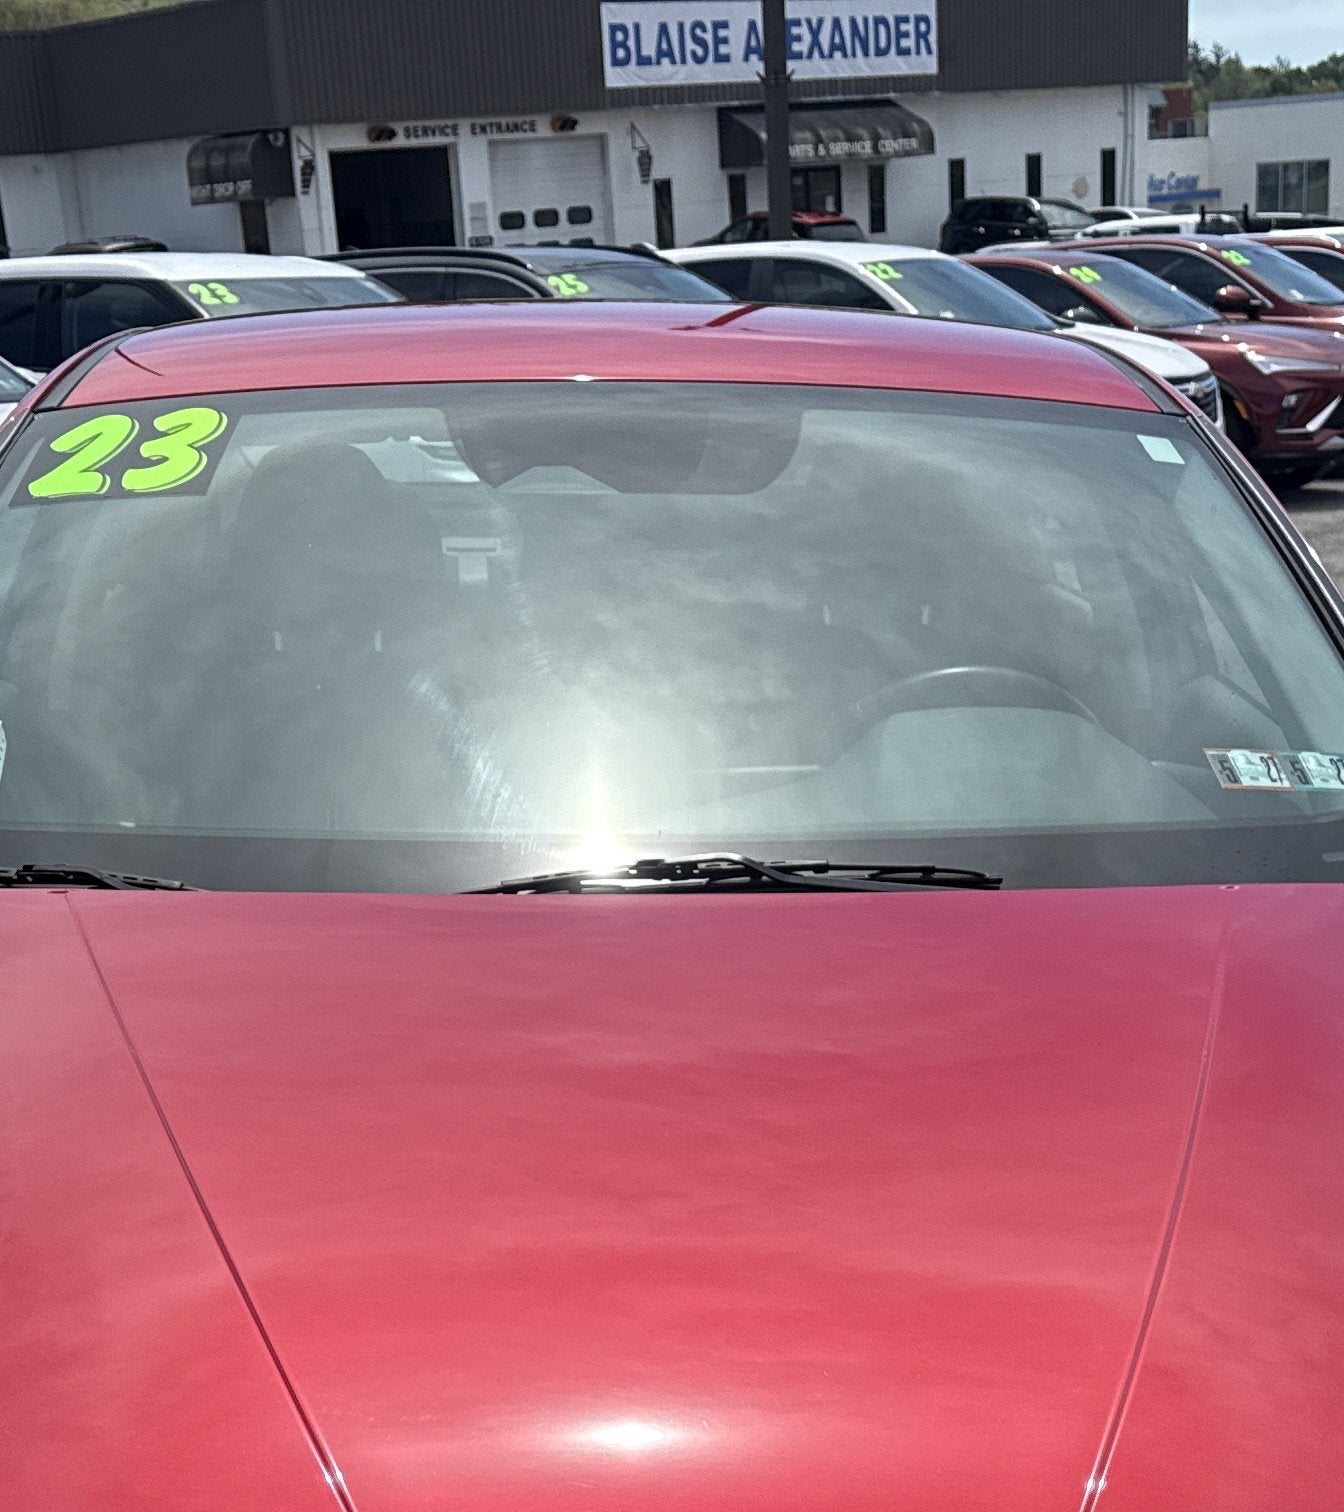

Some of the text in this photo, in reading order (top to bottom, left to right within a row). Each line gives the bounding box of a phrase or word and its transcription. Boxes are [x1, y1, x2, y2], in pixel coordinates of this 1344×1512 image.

[608, 13, 933, 68] BLAISE AEXANDER
[402, 119, 538, 139] SERVICE ENTRANCE
[829, 140, 873, 156] SERVICE
[877, 136, 920, 153] CENTER
[187, 282, 240, 305] 23
[546, 272, 589, 296] 25
[27, 406, 228, 499] 23
[1259, 755, 1284, 786] 27
